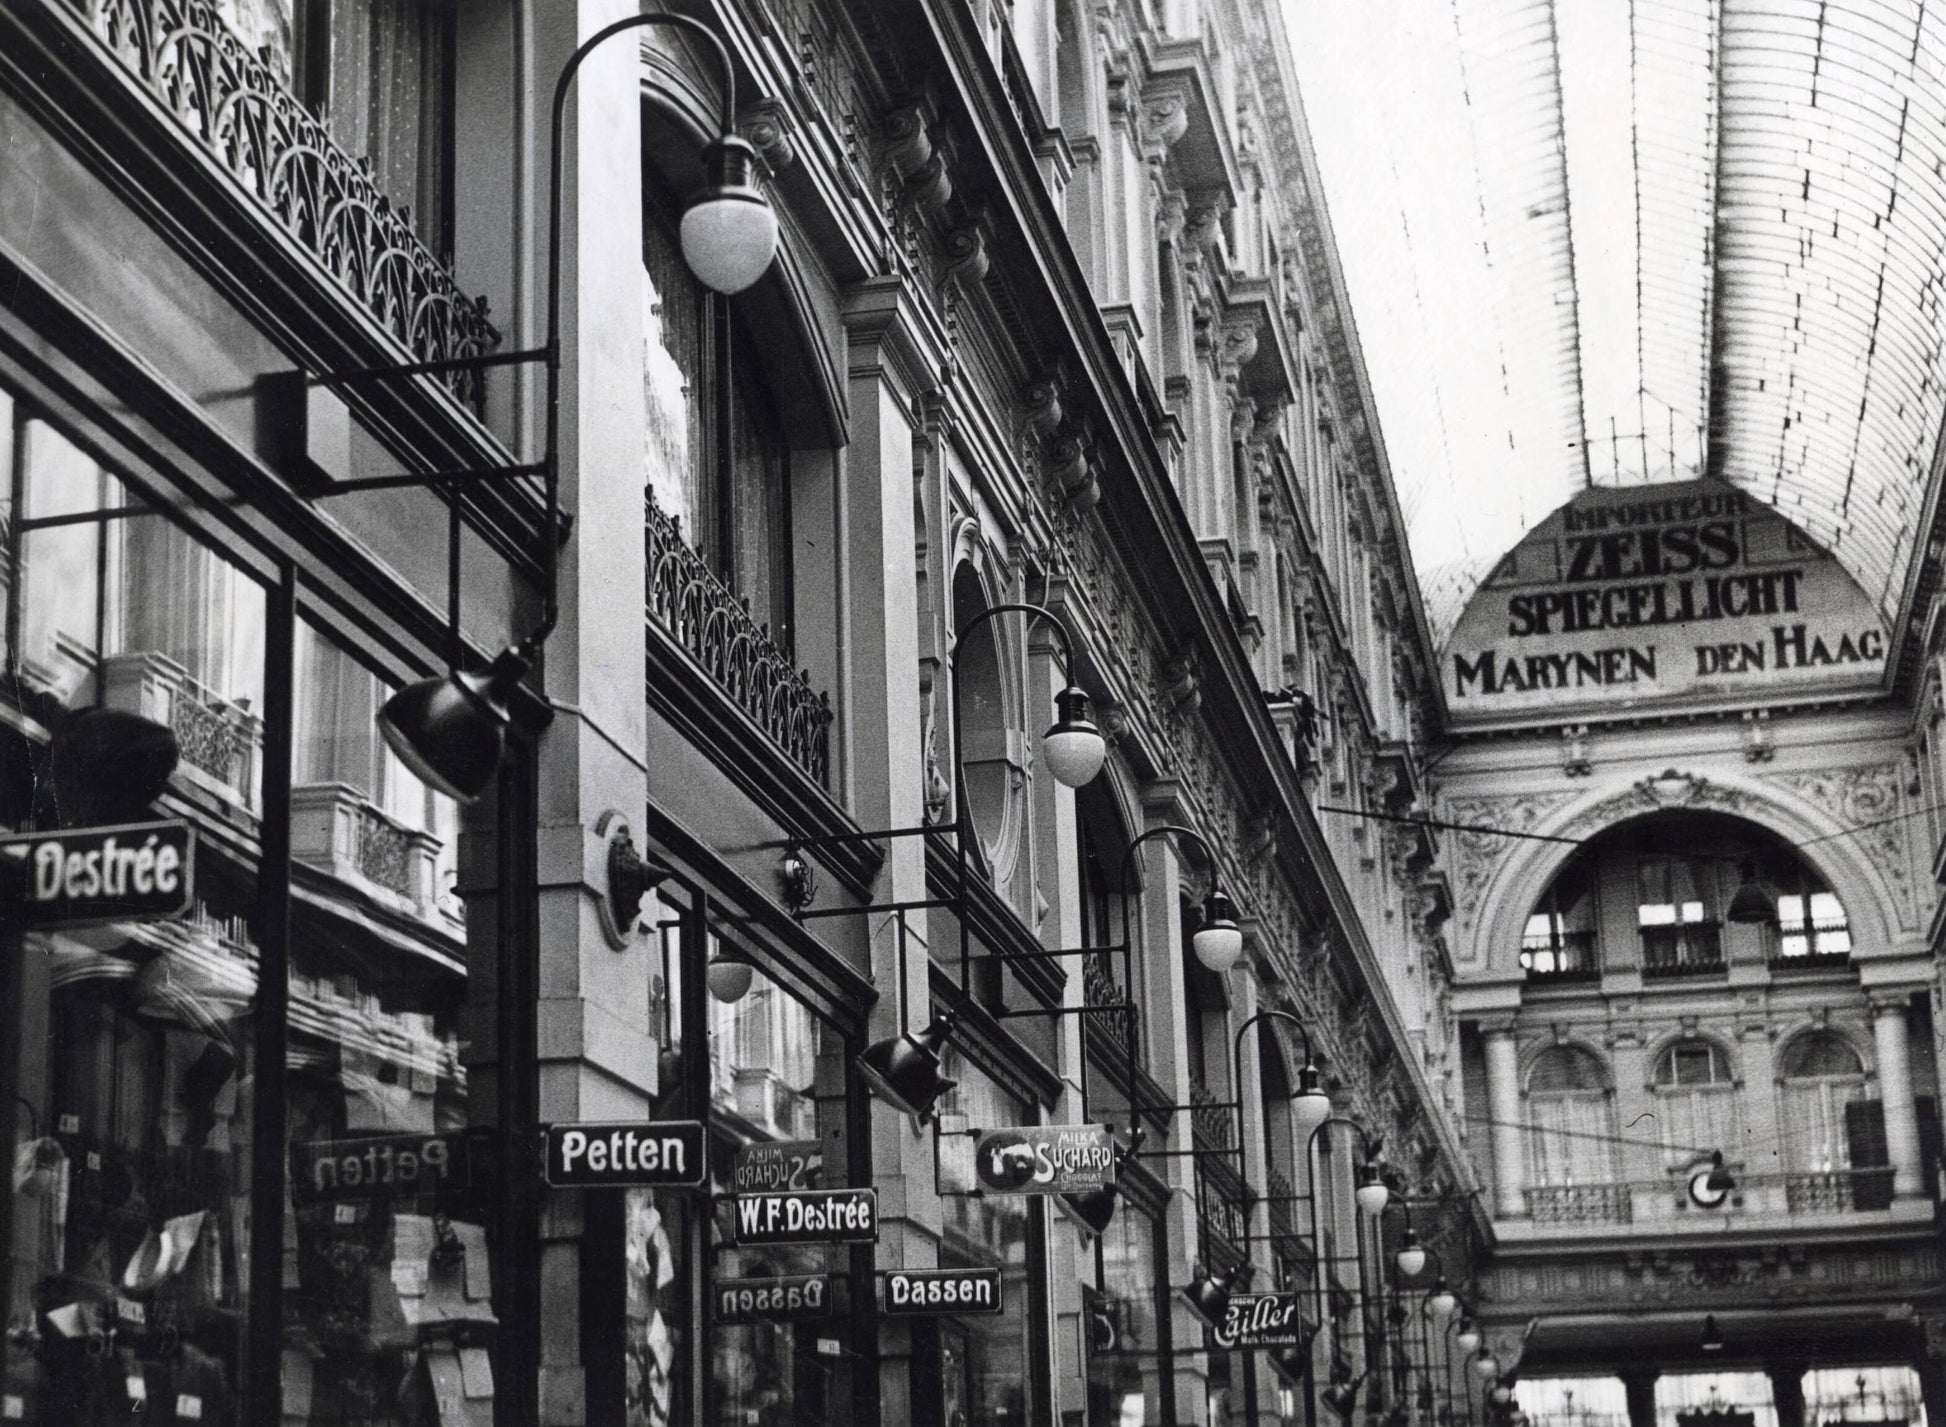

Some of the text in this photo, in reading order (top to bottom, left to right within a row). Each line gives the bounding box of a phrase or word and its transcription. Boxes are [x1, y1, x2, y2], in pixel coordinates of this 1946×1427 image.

[1564, 494, 1747, 531] IMPORTEUR
[1567, 521, 1742, 583] ZEISS
[1508, 570, 1804, 638] SPIEGELLICHT
[1453, 624, 1885, 697] MARYNEN DEN HAAG
[33, 832, 181, 902] Destrée
[561, 1130, 686, 1174] Petten
[1058, 1131, 1099, 1147] MILKA
[1032, 1142, 1112, 1183] SUCHARD
[890, 1274, 992, 1306] Dassen
